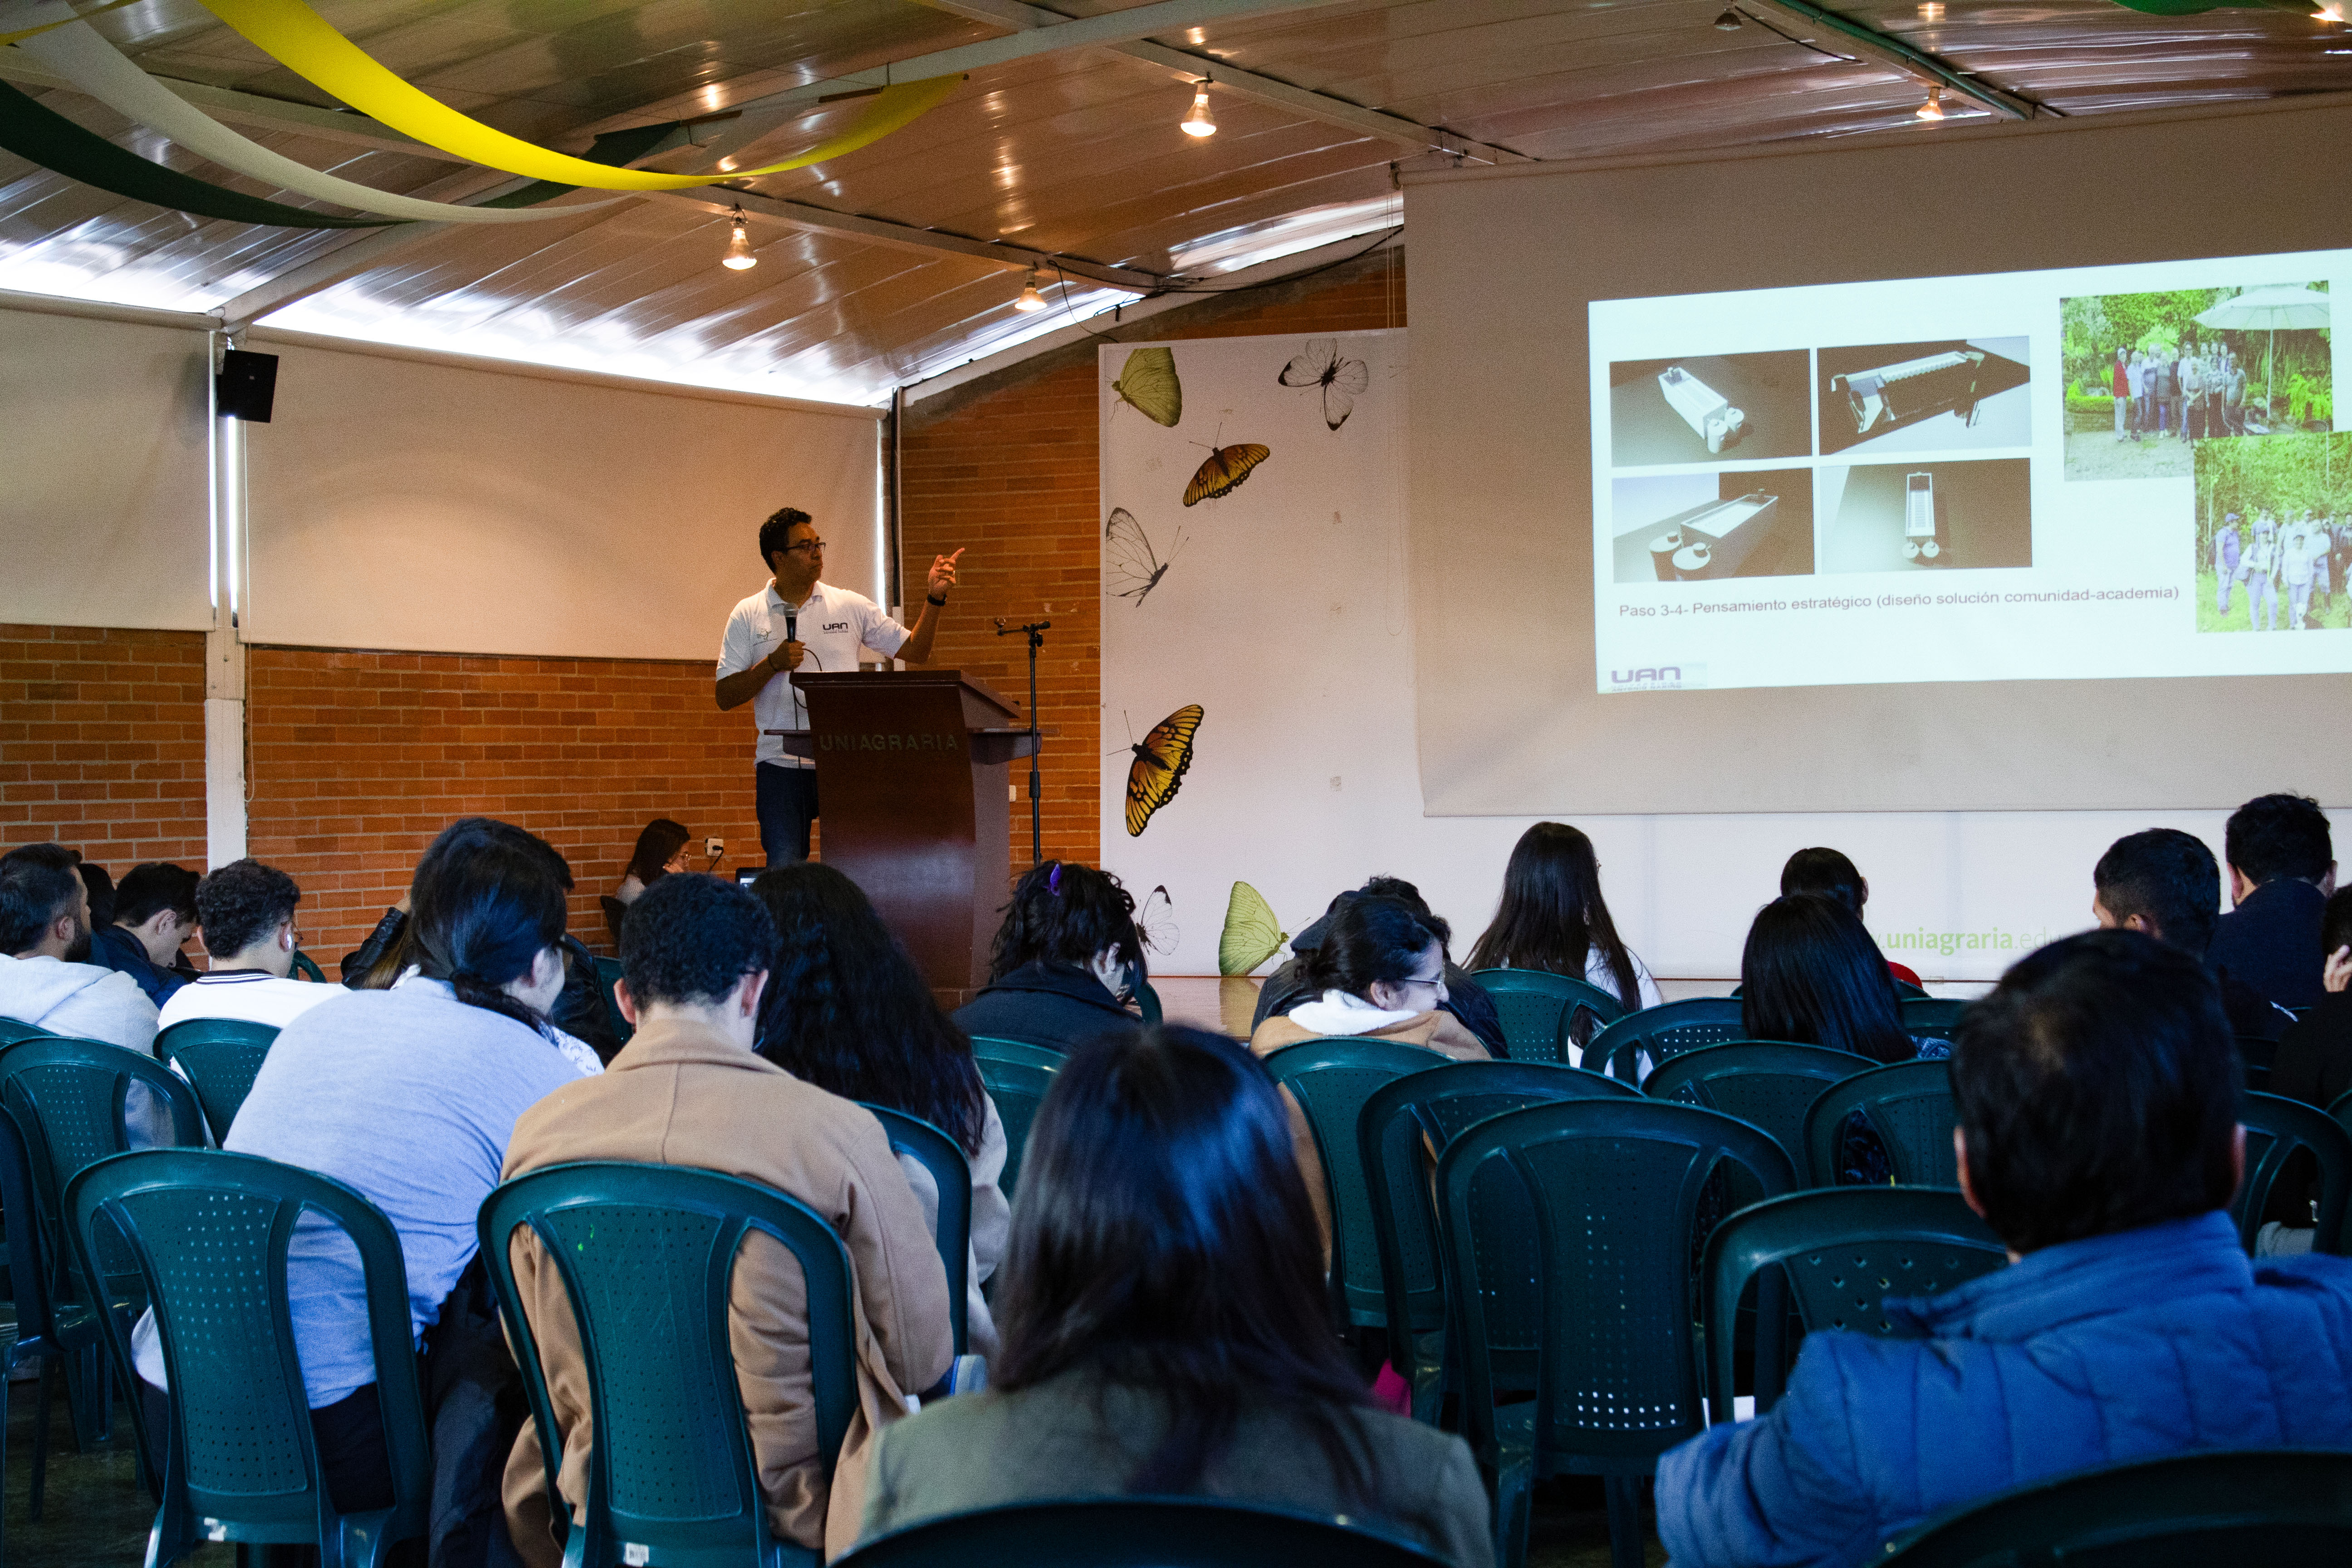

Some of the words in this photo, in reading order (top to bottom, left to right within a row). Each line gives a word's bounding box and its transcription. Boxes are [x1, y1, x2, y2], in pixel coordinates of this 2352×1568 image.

[1619, 605, 1656, 617] Paso
[1661, 604, 1689, 616] 3-4-
[1693, 599, 1787, 614] Pensamiento
[1791, 596, 1872, 611] estratégico
[1877, 593, 1932, 609] (diseño
[1936, 591, 1999, 605] solución
[2004, 586, 2180, 603] comunidad-academia)
[1611, 666, 1681, 684] UAN
[818, 733, 959, 751] UNIAGRARIA
